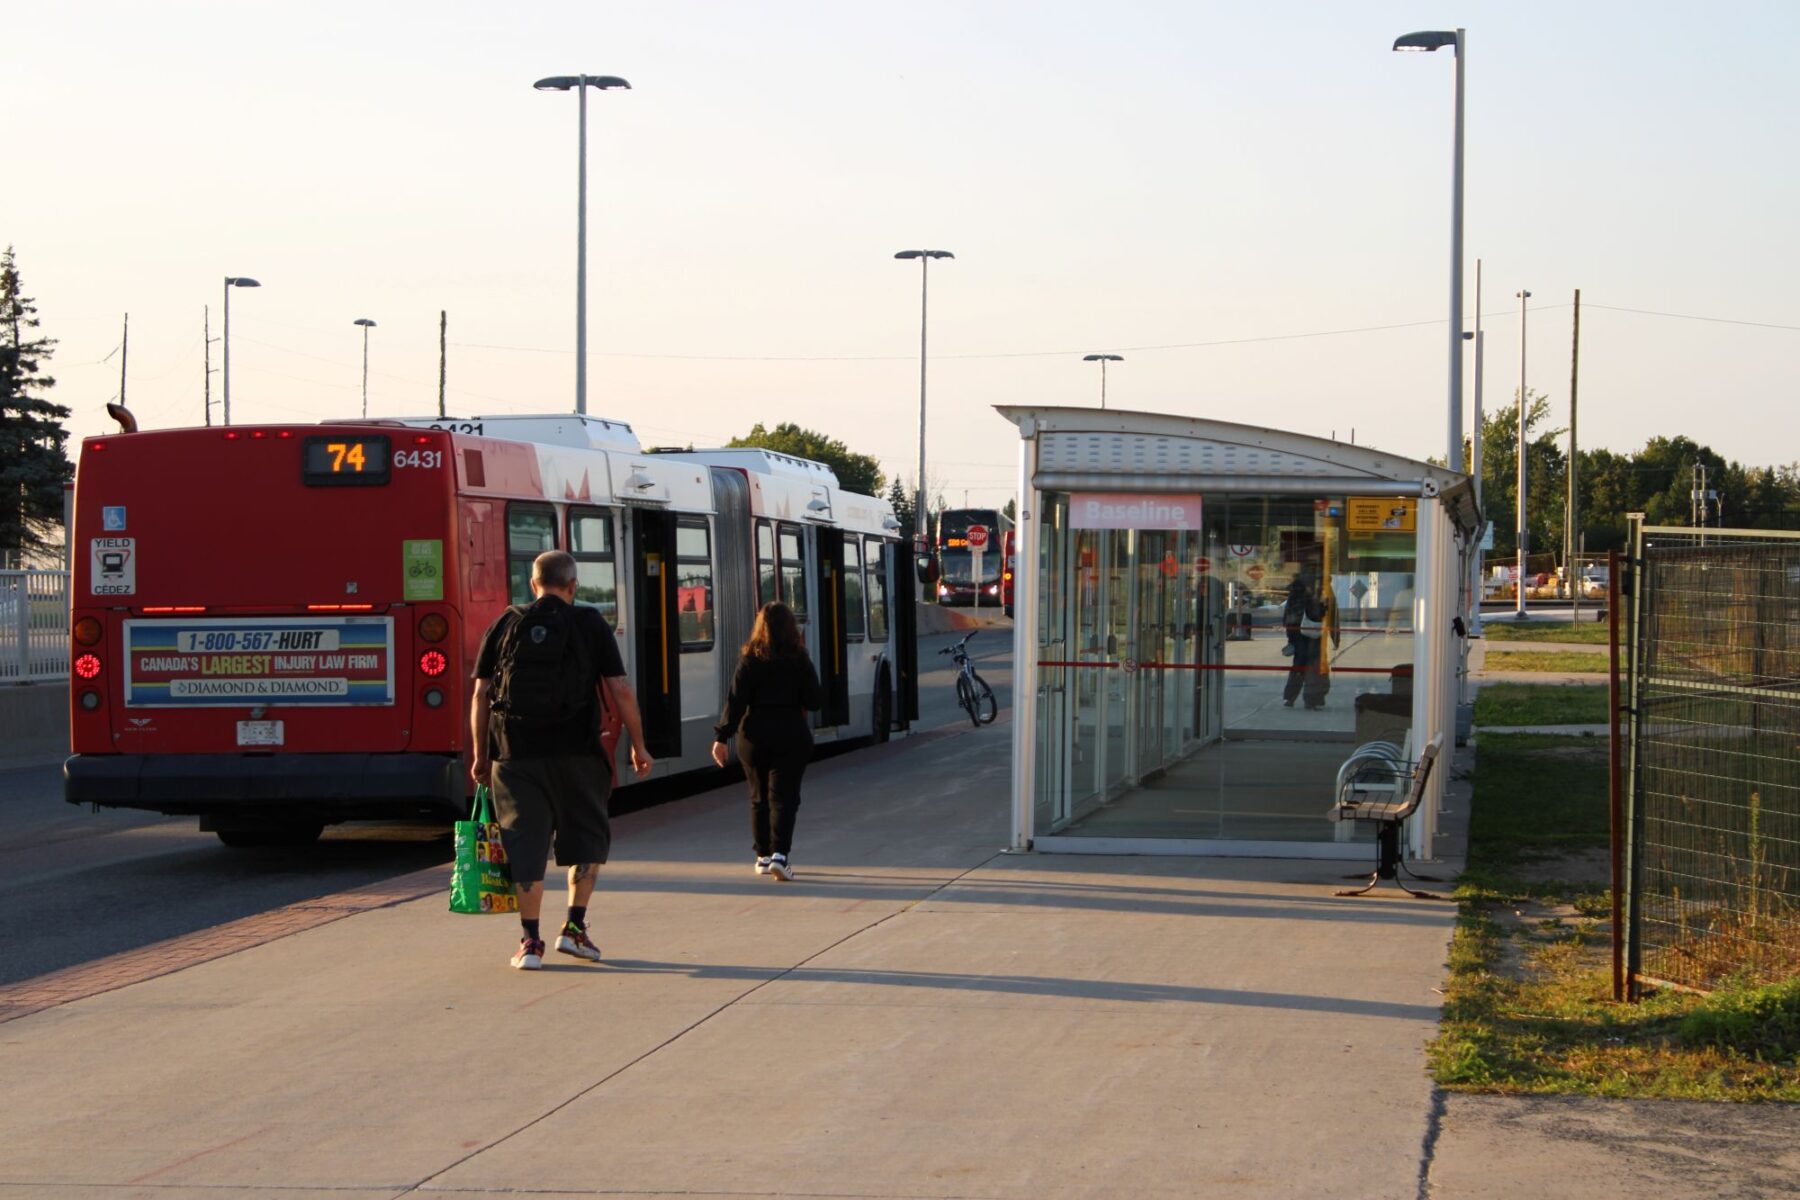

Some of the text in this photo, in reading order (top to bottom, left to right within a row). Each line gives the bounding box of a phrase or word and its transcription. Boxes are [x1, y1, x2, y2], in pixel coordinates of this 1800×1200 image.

[327, 443, 365, 472] 74
[393, 450, 442, 468] 6431
[1086, 500, 1185, 521] Baseline
[94, 539, 131, 548] YIELD
[969, 531, 987, 541] STOP
[189, 631, 323, 651] 1-800-567-HURT
[140, 655, 378, 675] CANADA'S LARGEST INJURY LAW FIRM
[188, 681, 255, 695] DIAMOND
[257, 682, 268, 693] &
[271, 681, 340, 694] DIAMOND
